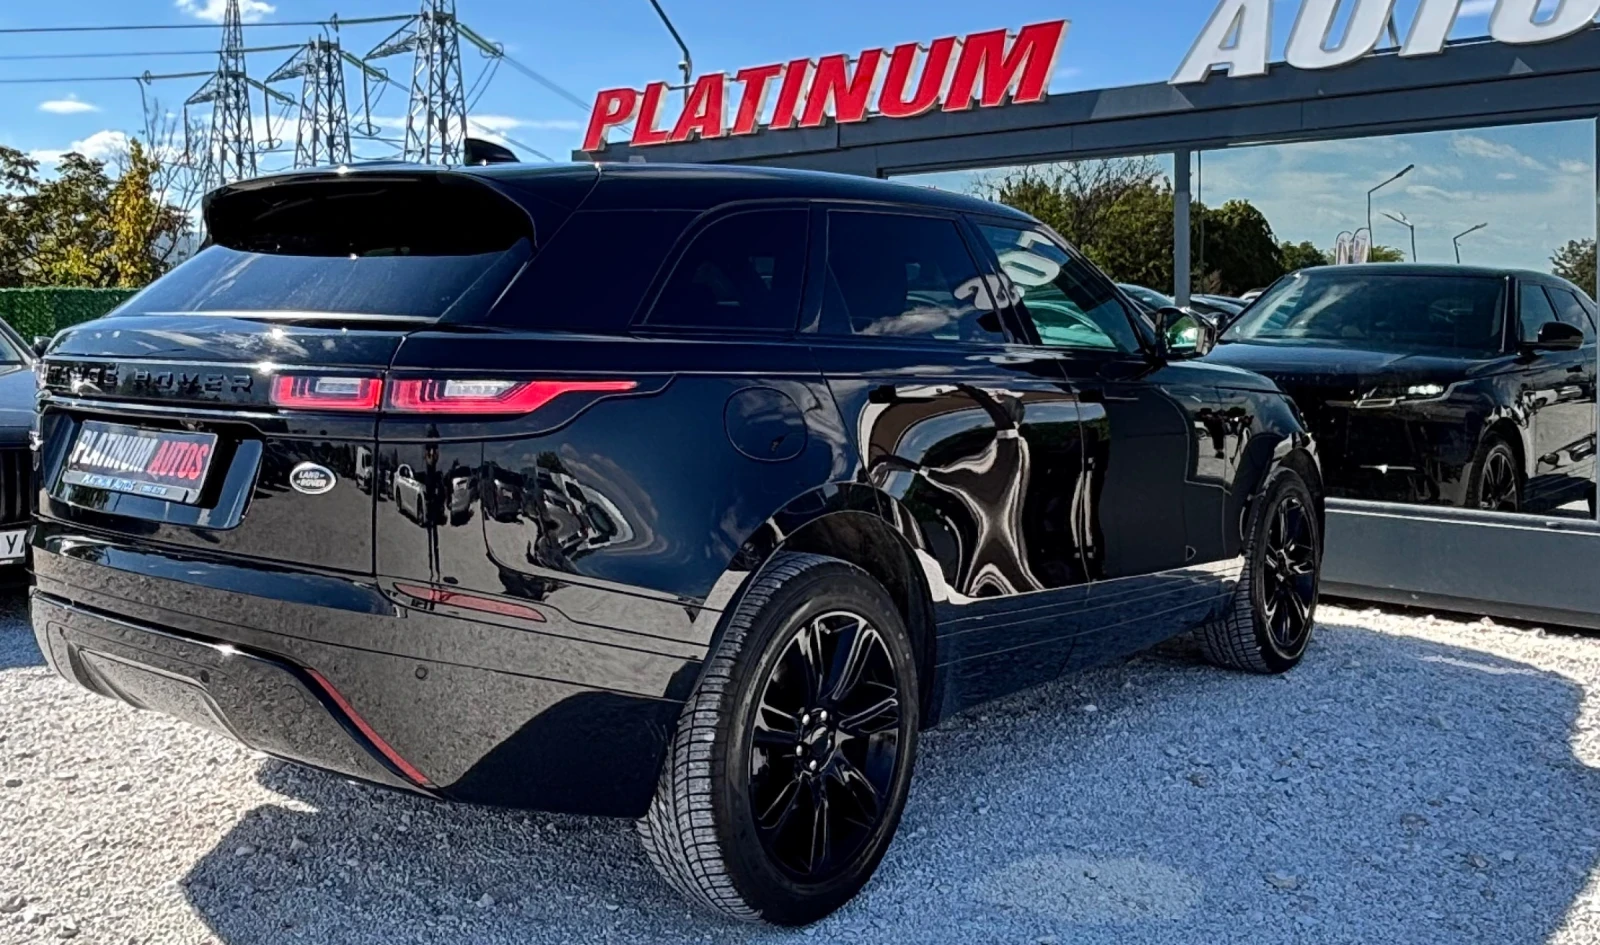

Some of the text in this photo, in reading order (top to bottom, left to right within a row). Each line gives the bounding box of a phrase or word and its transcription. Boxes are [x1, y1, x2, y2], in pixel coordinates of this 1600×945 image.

[581, 19, 1070, 152] PLATINUM
[134, 370, 254, 393] ROVER
[71, 430, 209, 480] PLATINUM AUTOS
